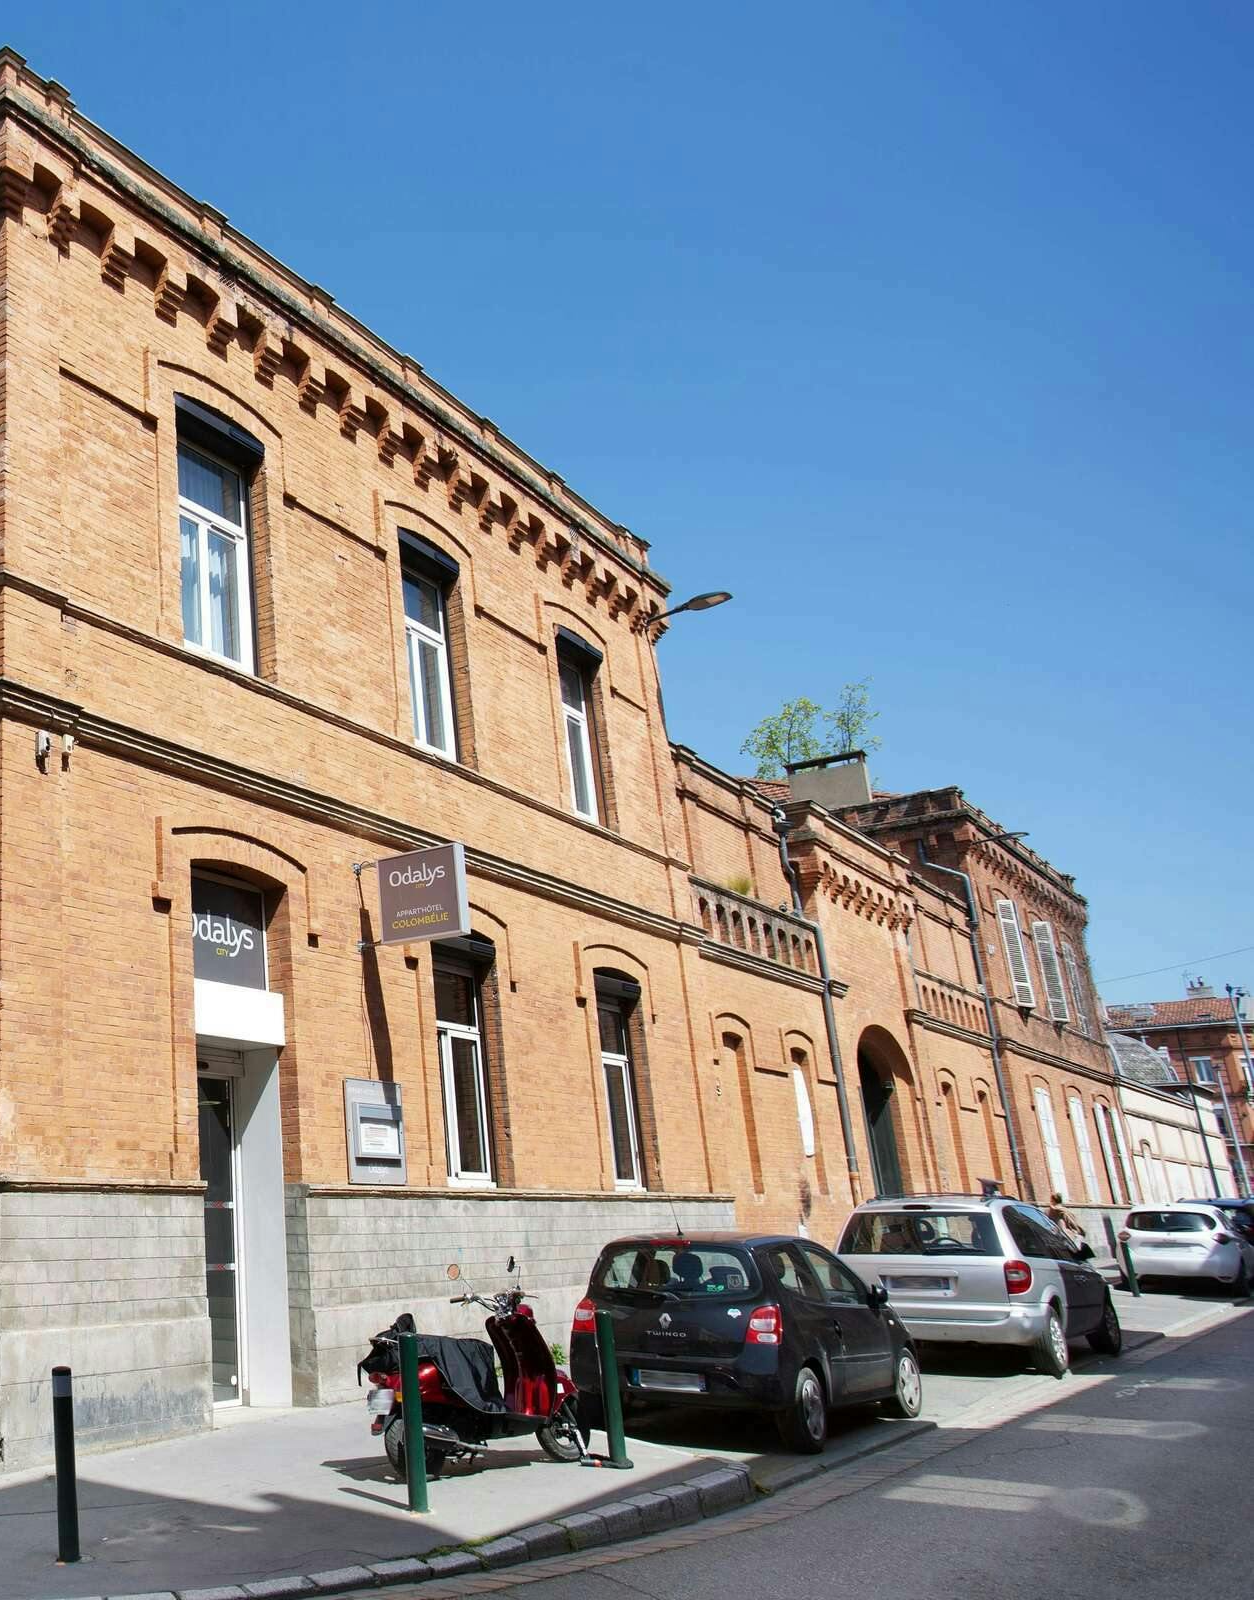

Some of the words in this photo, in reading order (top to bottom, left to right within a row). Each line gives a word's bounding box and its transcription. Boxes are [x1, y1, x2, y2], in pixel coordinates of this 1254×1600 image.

[389, 863, 445, 888] Odalys
[396, 903, 444, 917] APPART'HÔTEL
[392, 912, 449, 930] COLOMBÉLIE
[645, 1330, 688, 1339] TWINGO
